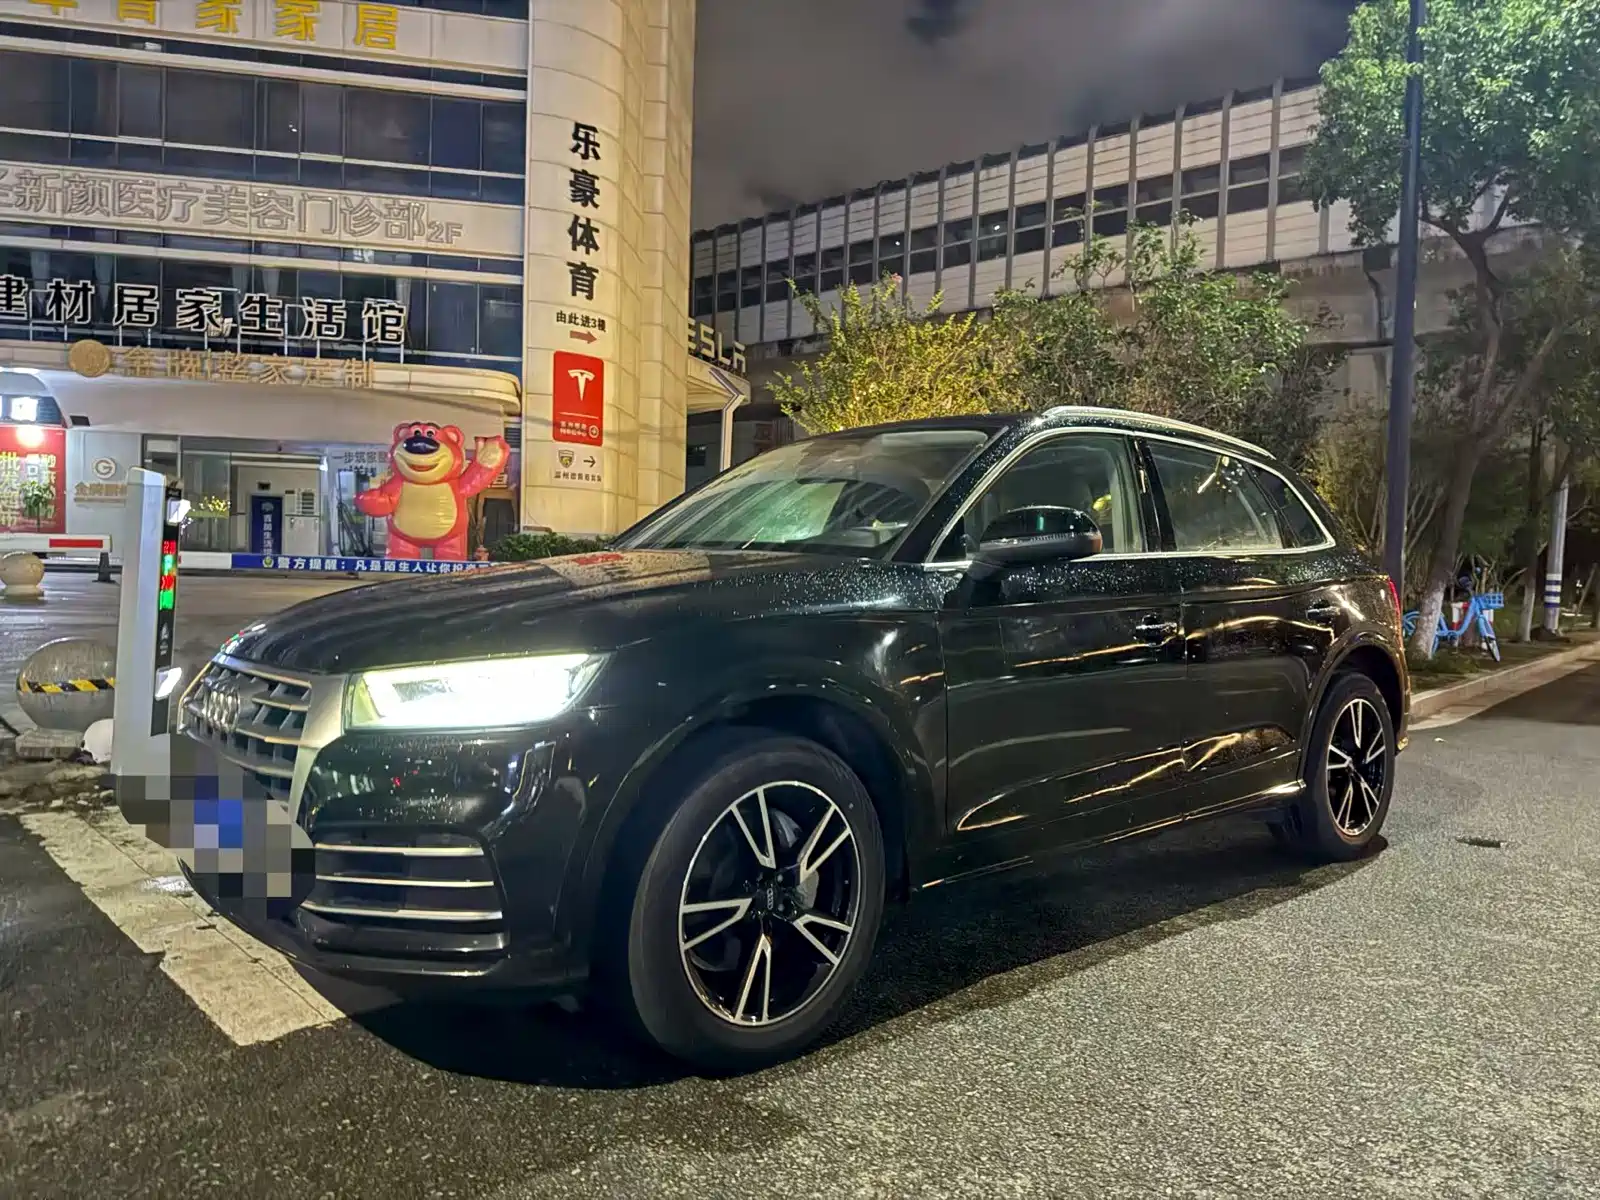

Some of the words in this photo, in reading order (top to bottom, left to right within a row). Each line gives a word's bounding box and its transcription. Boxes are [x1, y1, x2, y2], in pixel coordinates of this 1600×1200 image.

[567, 122, 601, 301] 乐豪体育
[0, 274, 406, 344] 建材居家生活馆
